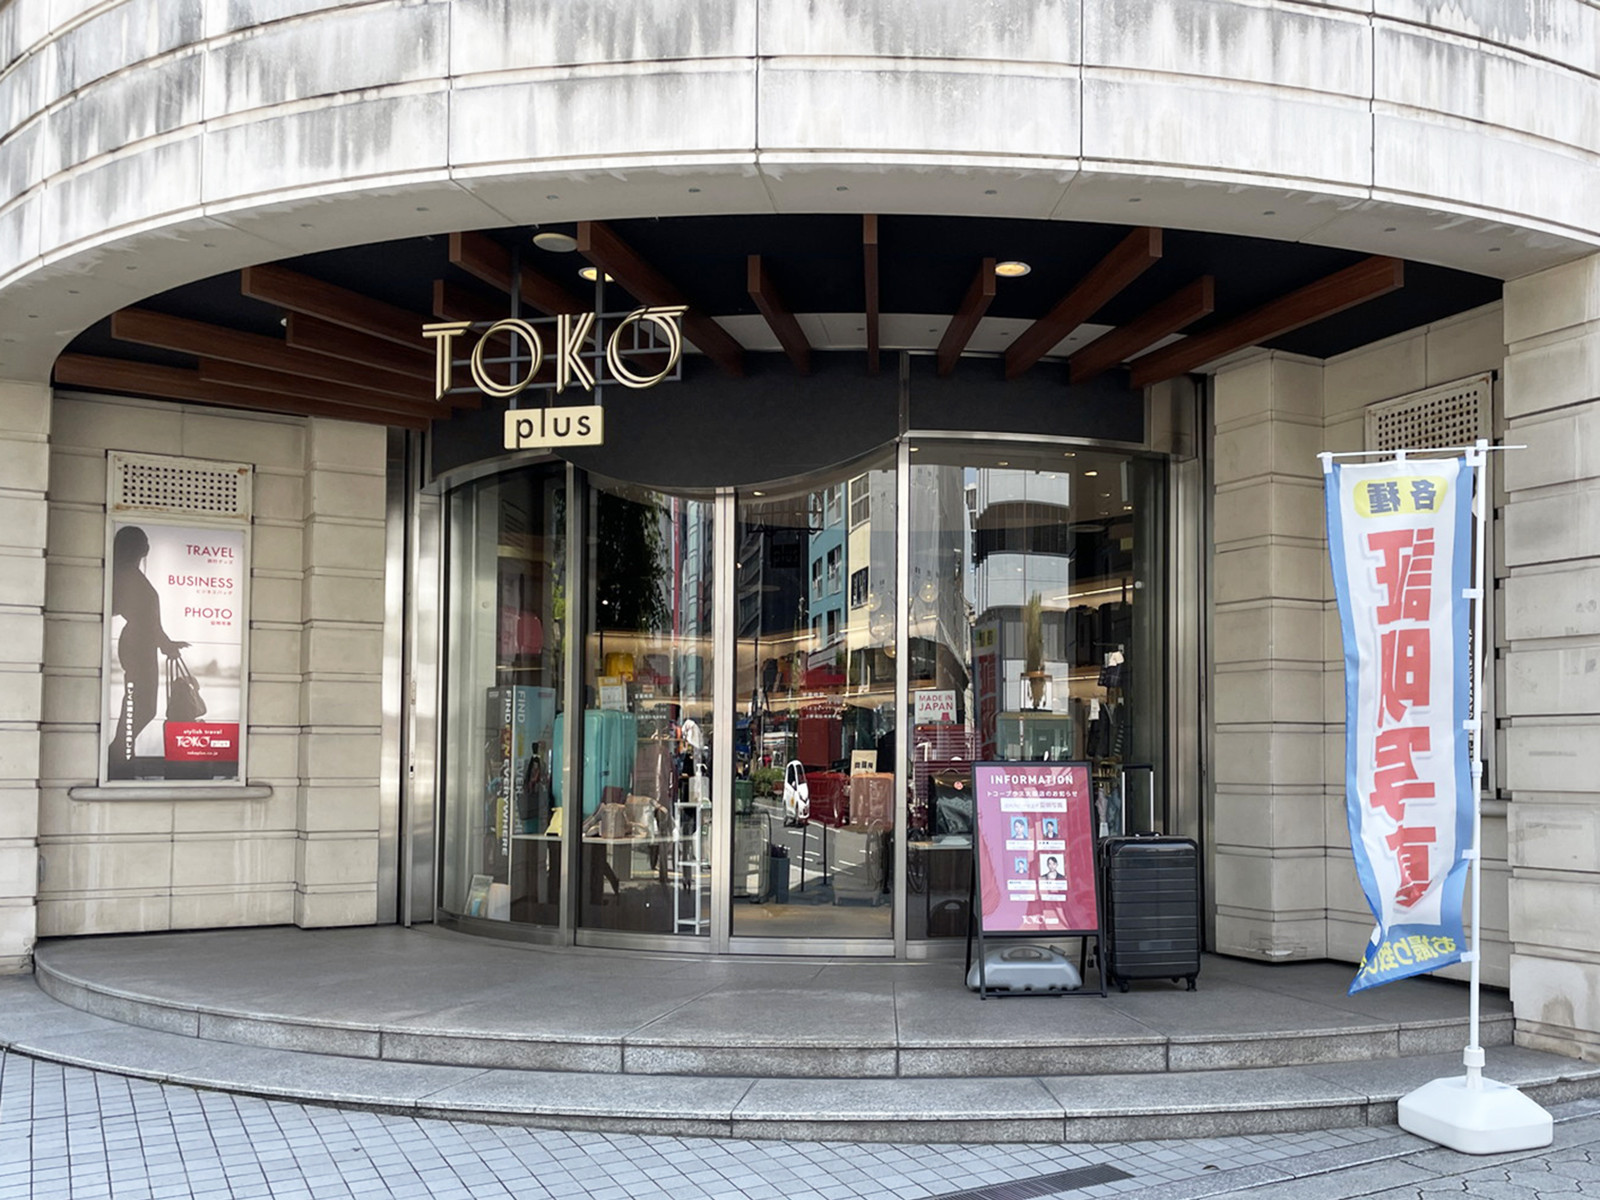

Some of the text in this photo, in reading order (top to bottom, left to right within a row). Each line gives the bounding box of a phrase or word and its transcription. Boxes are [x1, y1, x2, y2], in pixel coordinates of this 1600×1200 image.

[422, 305, 690, 401] TOKO
[516, 407, 592, 449] plus
[186, 544, 234, 558] TRAVEL
[168, 574, 234, 589] BUSINESS
[184, 607, 233, 620] PHOTO
[504, 690, 512, 723] FIND
[517, 690, 526, 723] FIND
[919, 702, 953, 711] JAPAN
[990, 774, 1074, 785] INFORMATION
[502, 758, 511, 857] EVERYWHERE
